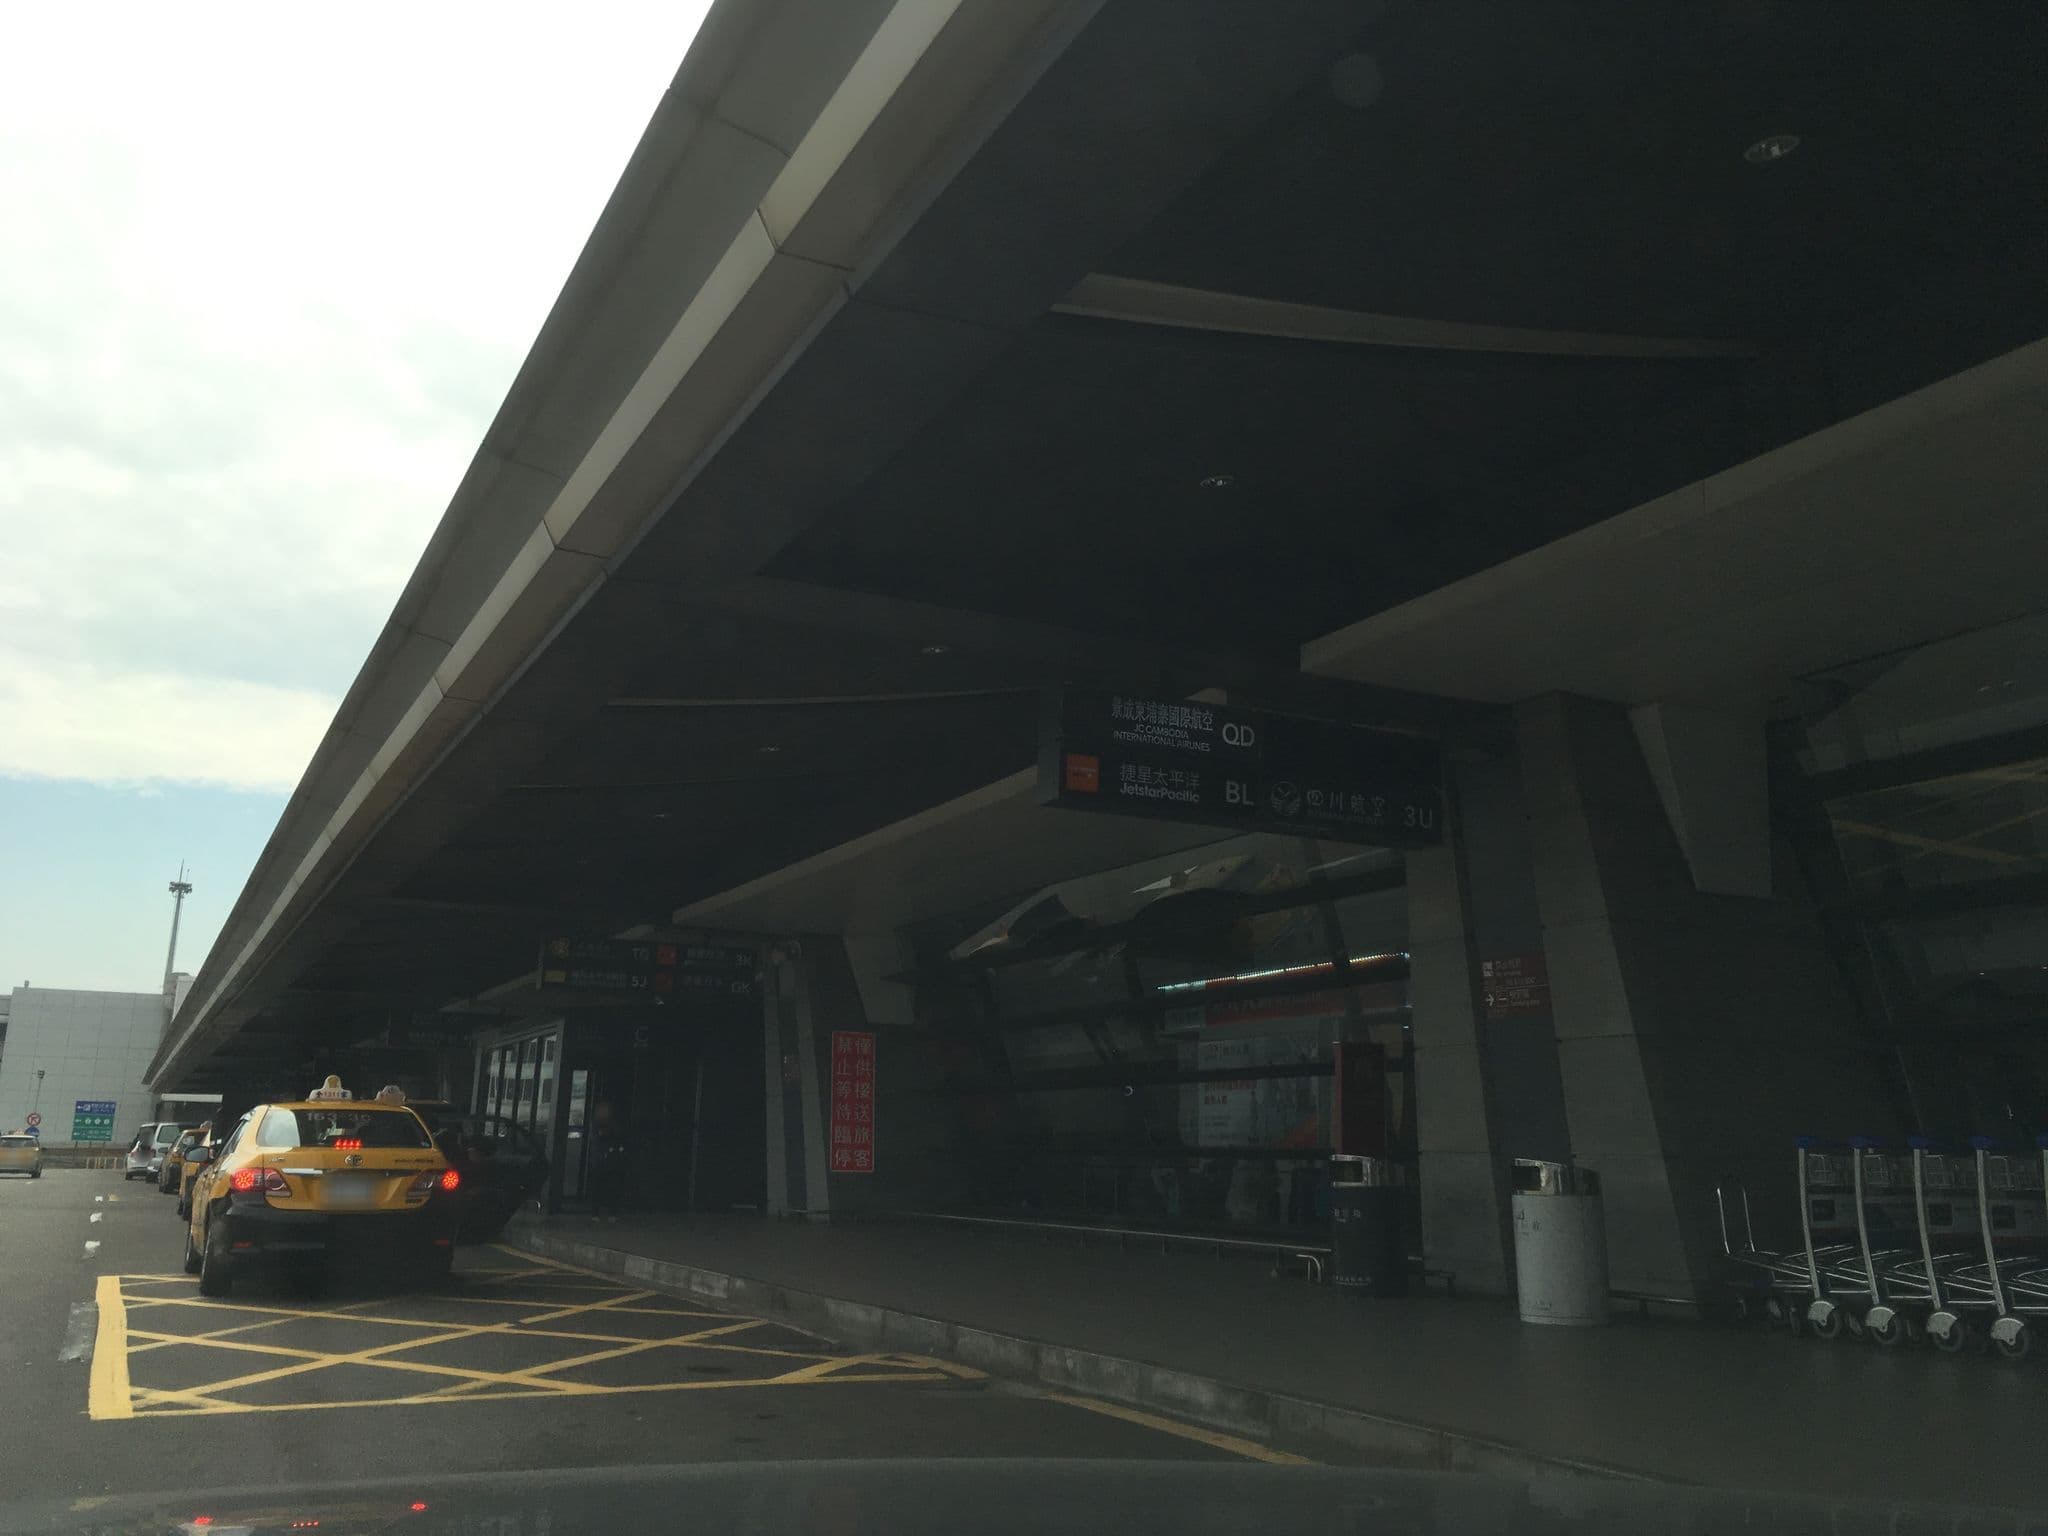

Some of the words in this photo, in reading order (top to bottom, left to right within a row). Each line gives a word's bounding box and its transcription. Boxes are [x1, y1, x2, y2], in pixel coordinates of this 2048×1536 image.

[1113, 730, 1175, 747] INTERNATIONAL
[1176, 739, 1211, 752] AIRLINES
[1145, 724, 1189, 739] CAMBODIA
[1222, 722, 1255, 747] QD
[1224, 779, 1255, 806] BL
[1403, 805, 1433, 830] 3U
